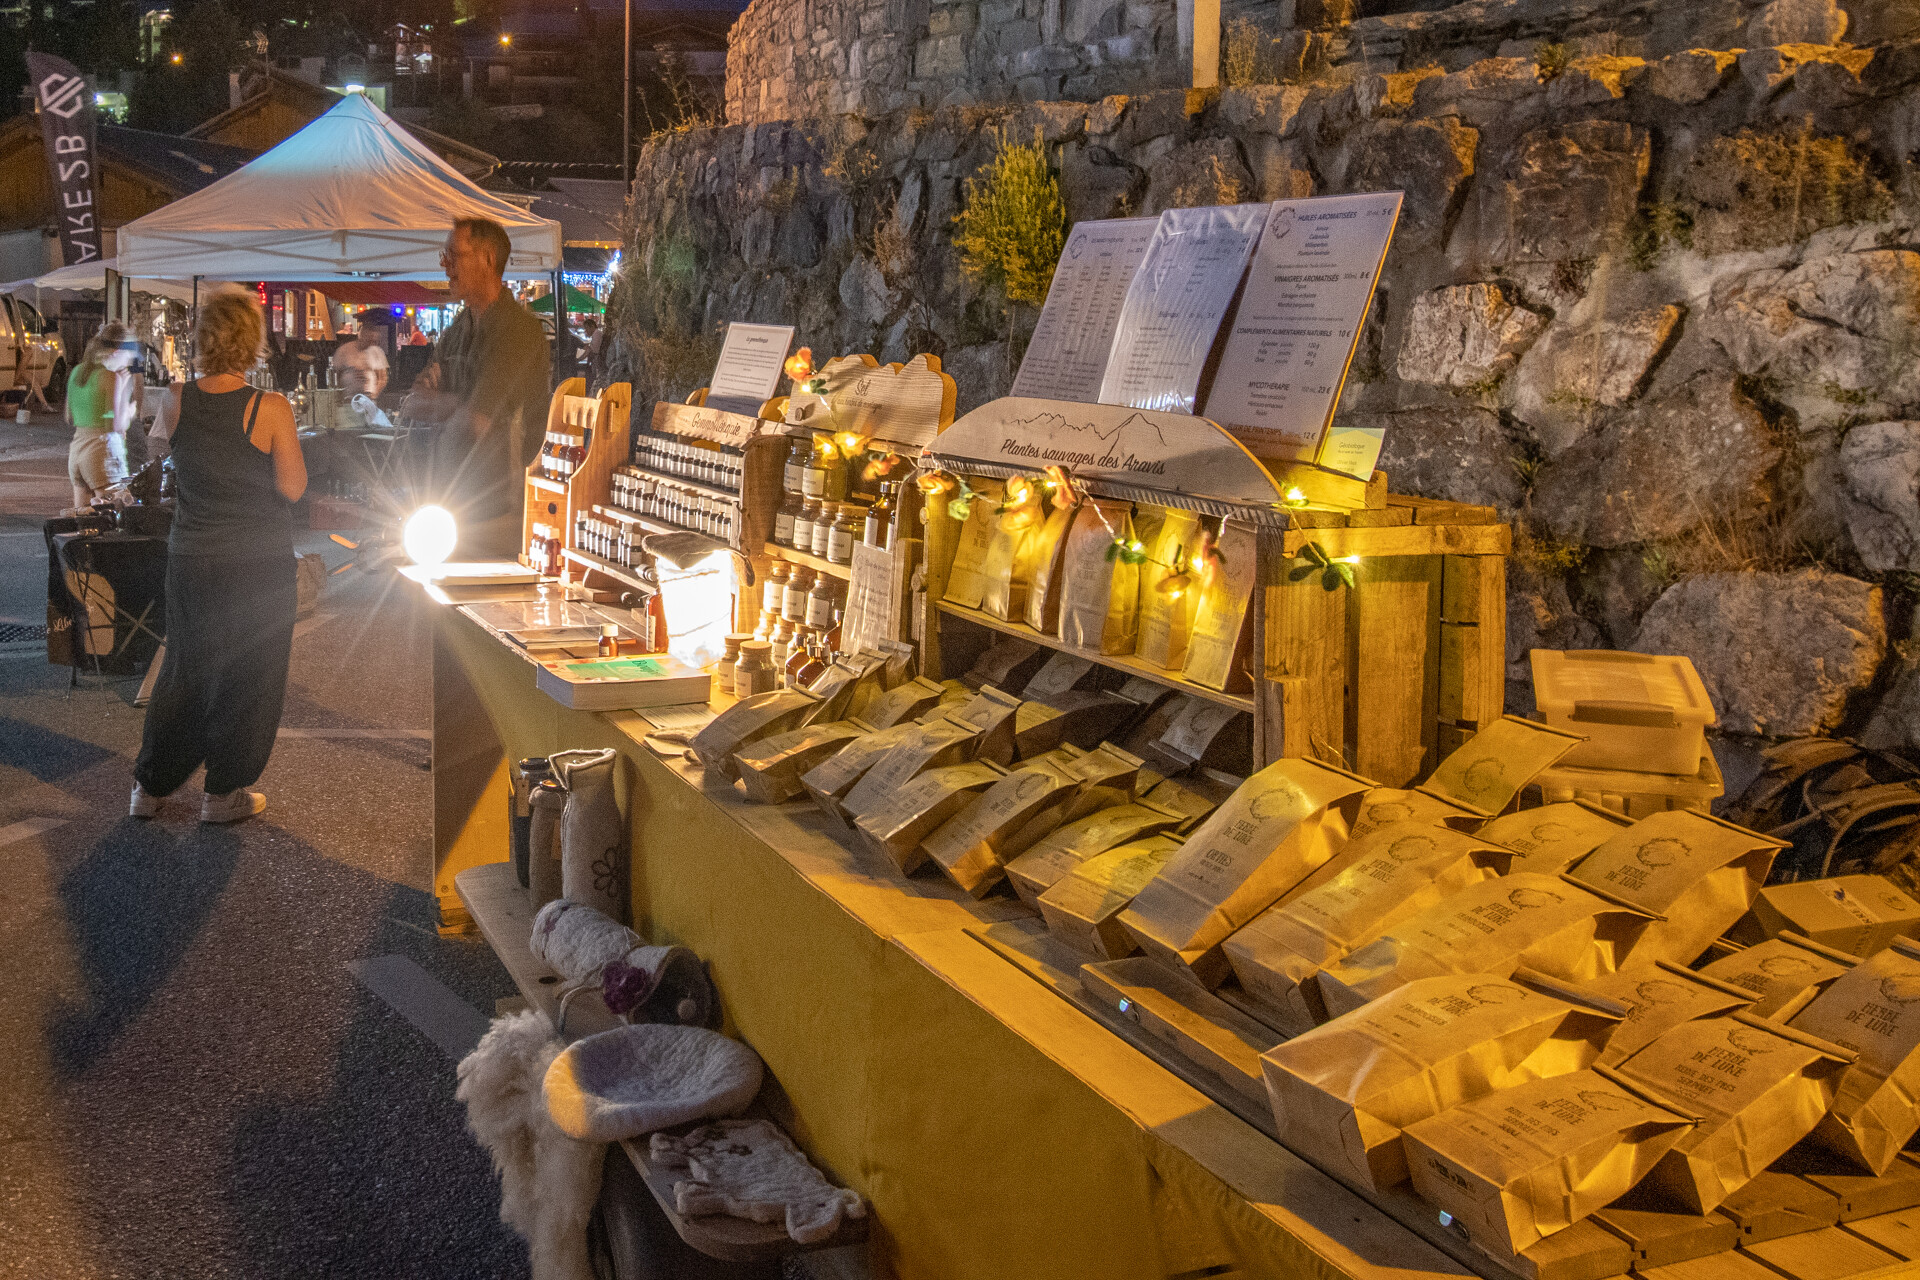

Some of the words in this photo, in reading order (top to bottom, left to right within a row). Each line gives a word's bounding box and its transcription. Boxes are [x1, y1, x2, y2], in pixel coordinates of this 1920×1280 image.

[1382, 208, 1388, 216] 5
[1338, 330, 1346, 338] 10
[1318, 386, 1326, 394] 23
[1303, 432, 1311, 440] 12
[1000, 438, 1041, 459] Plantes
[1042, 448, 1096, 472] sauvages
[1098, 452, 1120, 469] des
[1121, 454, 1167, 476] Aravis
[1861, 1002, 1902, 1024] HERBE
[1845, 1010, 1866, 1024] DE
[1864, 1017, 1900, 1037] LUNE
[1707, 1046, 1750, 1066] HERBE
[1690, 1050, 1712, 1064] DE
[1711, 1059, 1746, 1078] LUNE
[1699, 1074, 1716, 1084] DES
